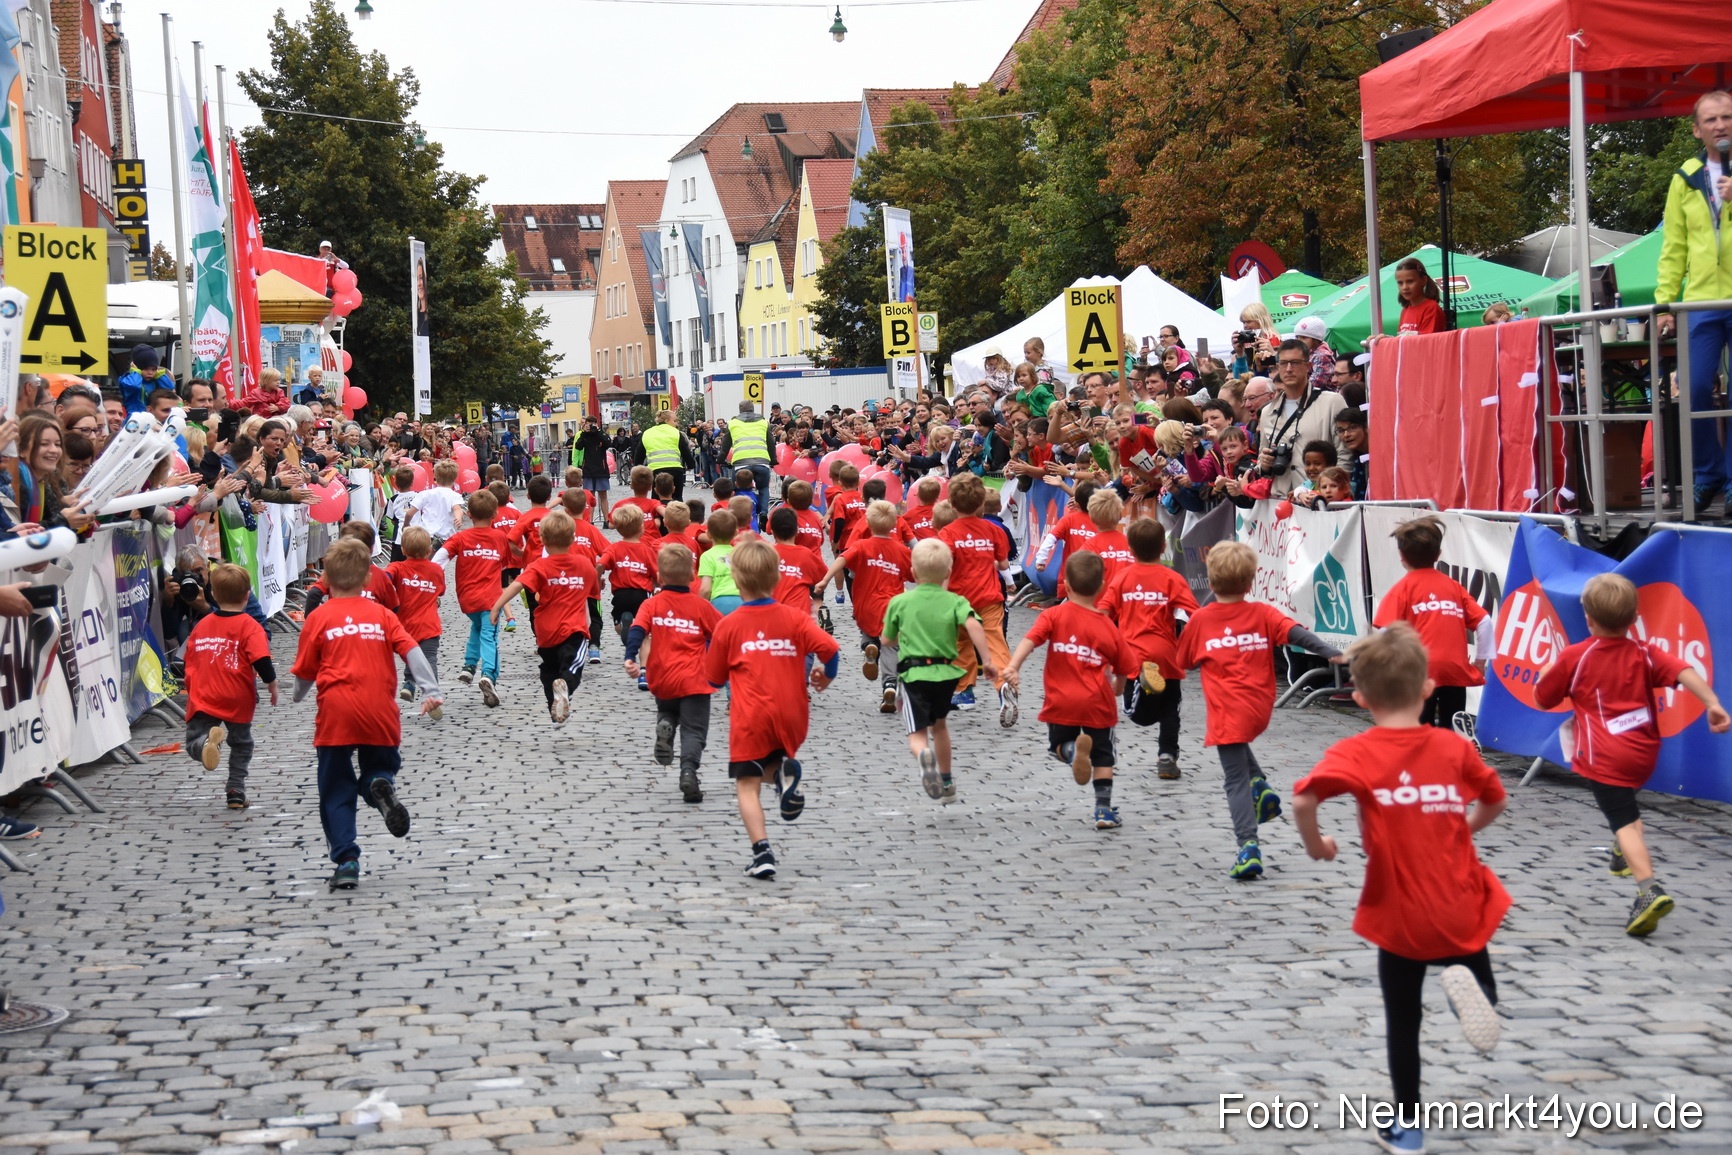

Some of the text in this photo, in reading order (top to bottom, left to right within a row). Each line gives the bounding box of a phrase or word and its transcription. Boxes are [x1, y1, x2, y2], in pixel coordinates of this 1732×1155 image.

[117, 163, 148, 281] HOTE
[18, 232, 97, 260] Block
[27, 272, 87, 343] A
[1071, 289, 1116, 306] Block
[885, 305, 913, 316] Block
[891, 319, 910, 346] B
[1079, 312, 1112, 354] A
[748, 383, 759, 398] C
[471, 409, 479, 419] D
[662, 401, 669, 411] D
